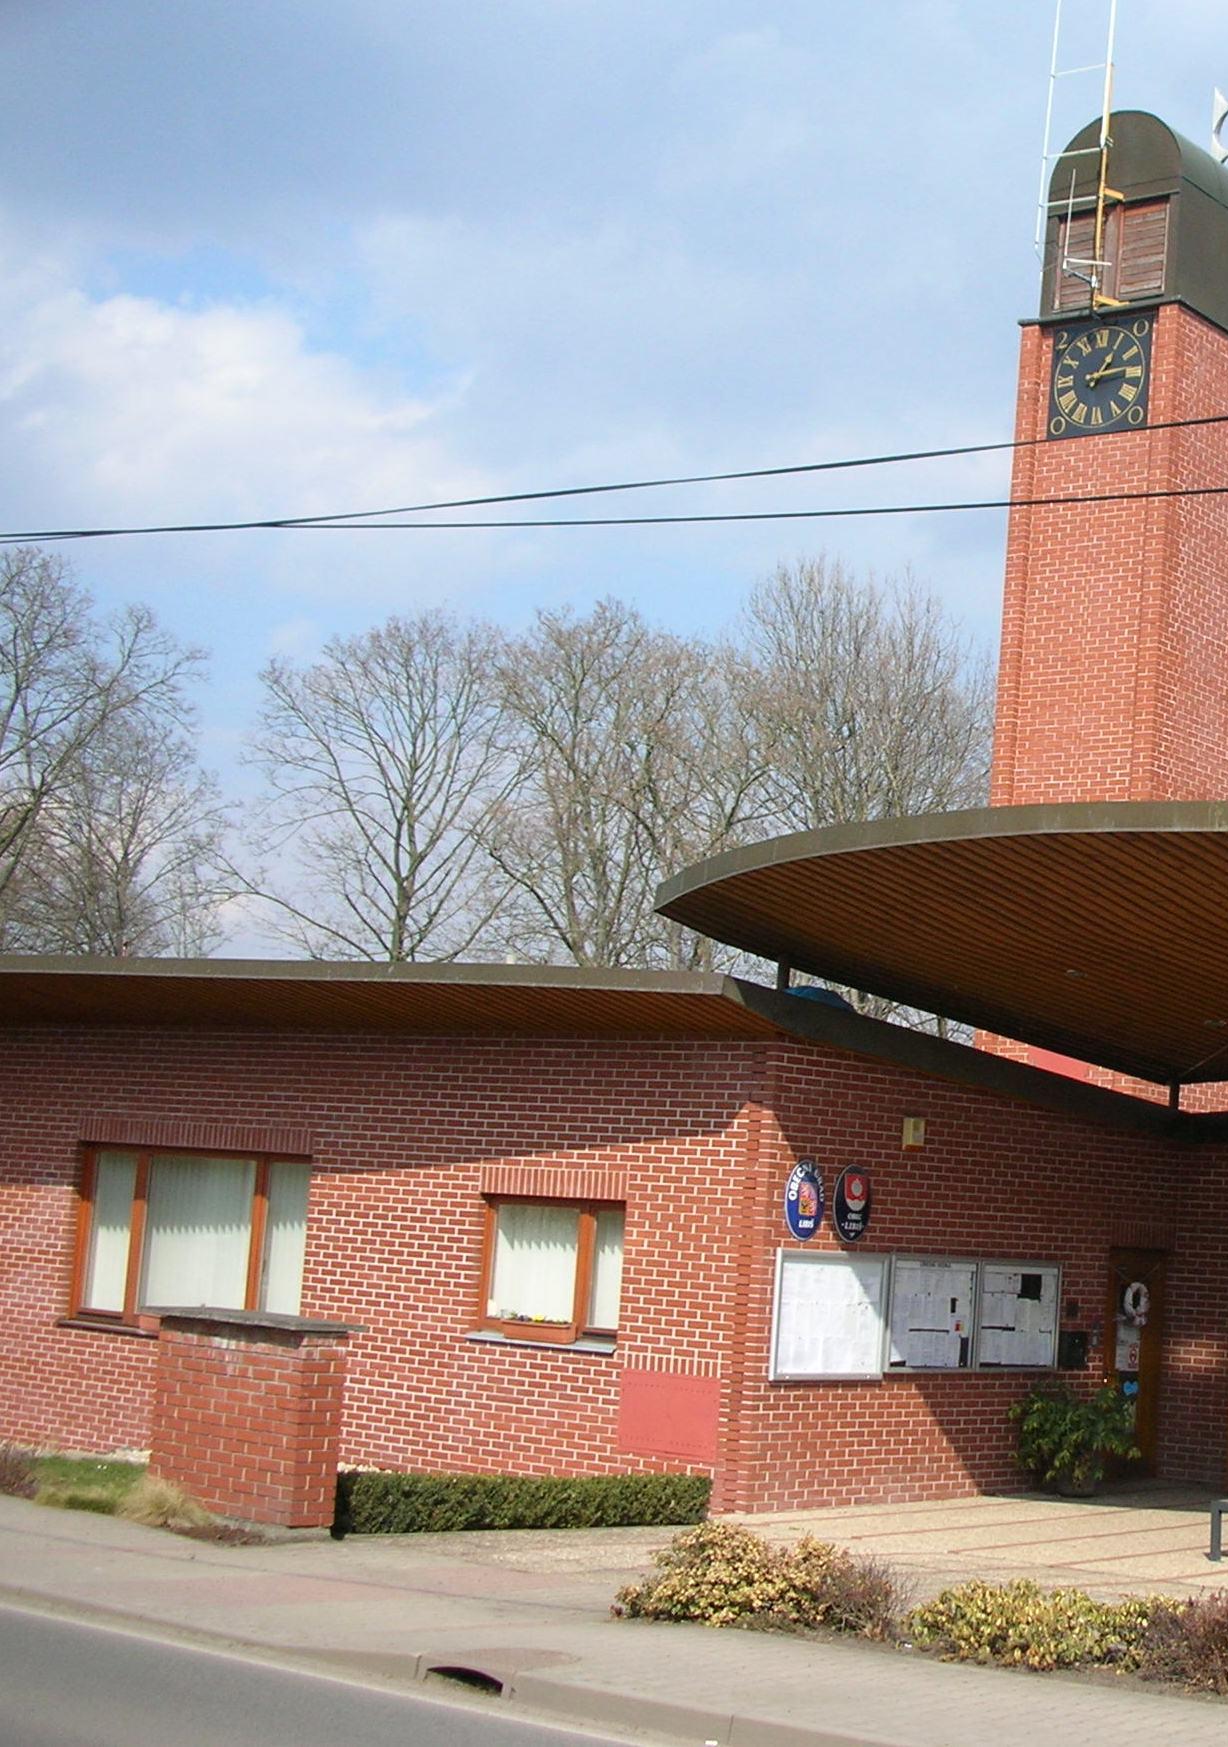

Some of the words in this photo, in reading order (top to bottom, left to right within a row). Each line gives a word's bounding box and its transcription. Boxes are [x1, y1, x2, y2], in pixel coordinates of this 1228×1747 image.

[1055, 331, 1068, 350] 2
[1076, 336, 1092, 357] XI
[1095, 329, 1109, 349] XII
[1122, 345, 1139, 361] II
[1063, 355, 1079, 369] X
[1125, 366, 1142, 378] III
[1057, 375, 1074, 388] IX
[1110, 401, 1122, 417] V
